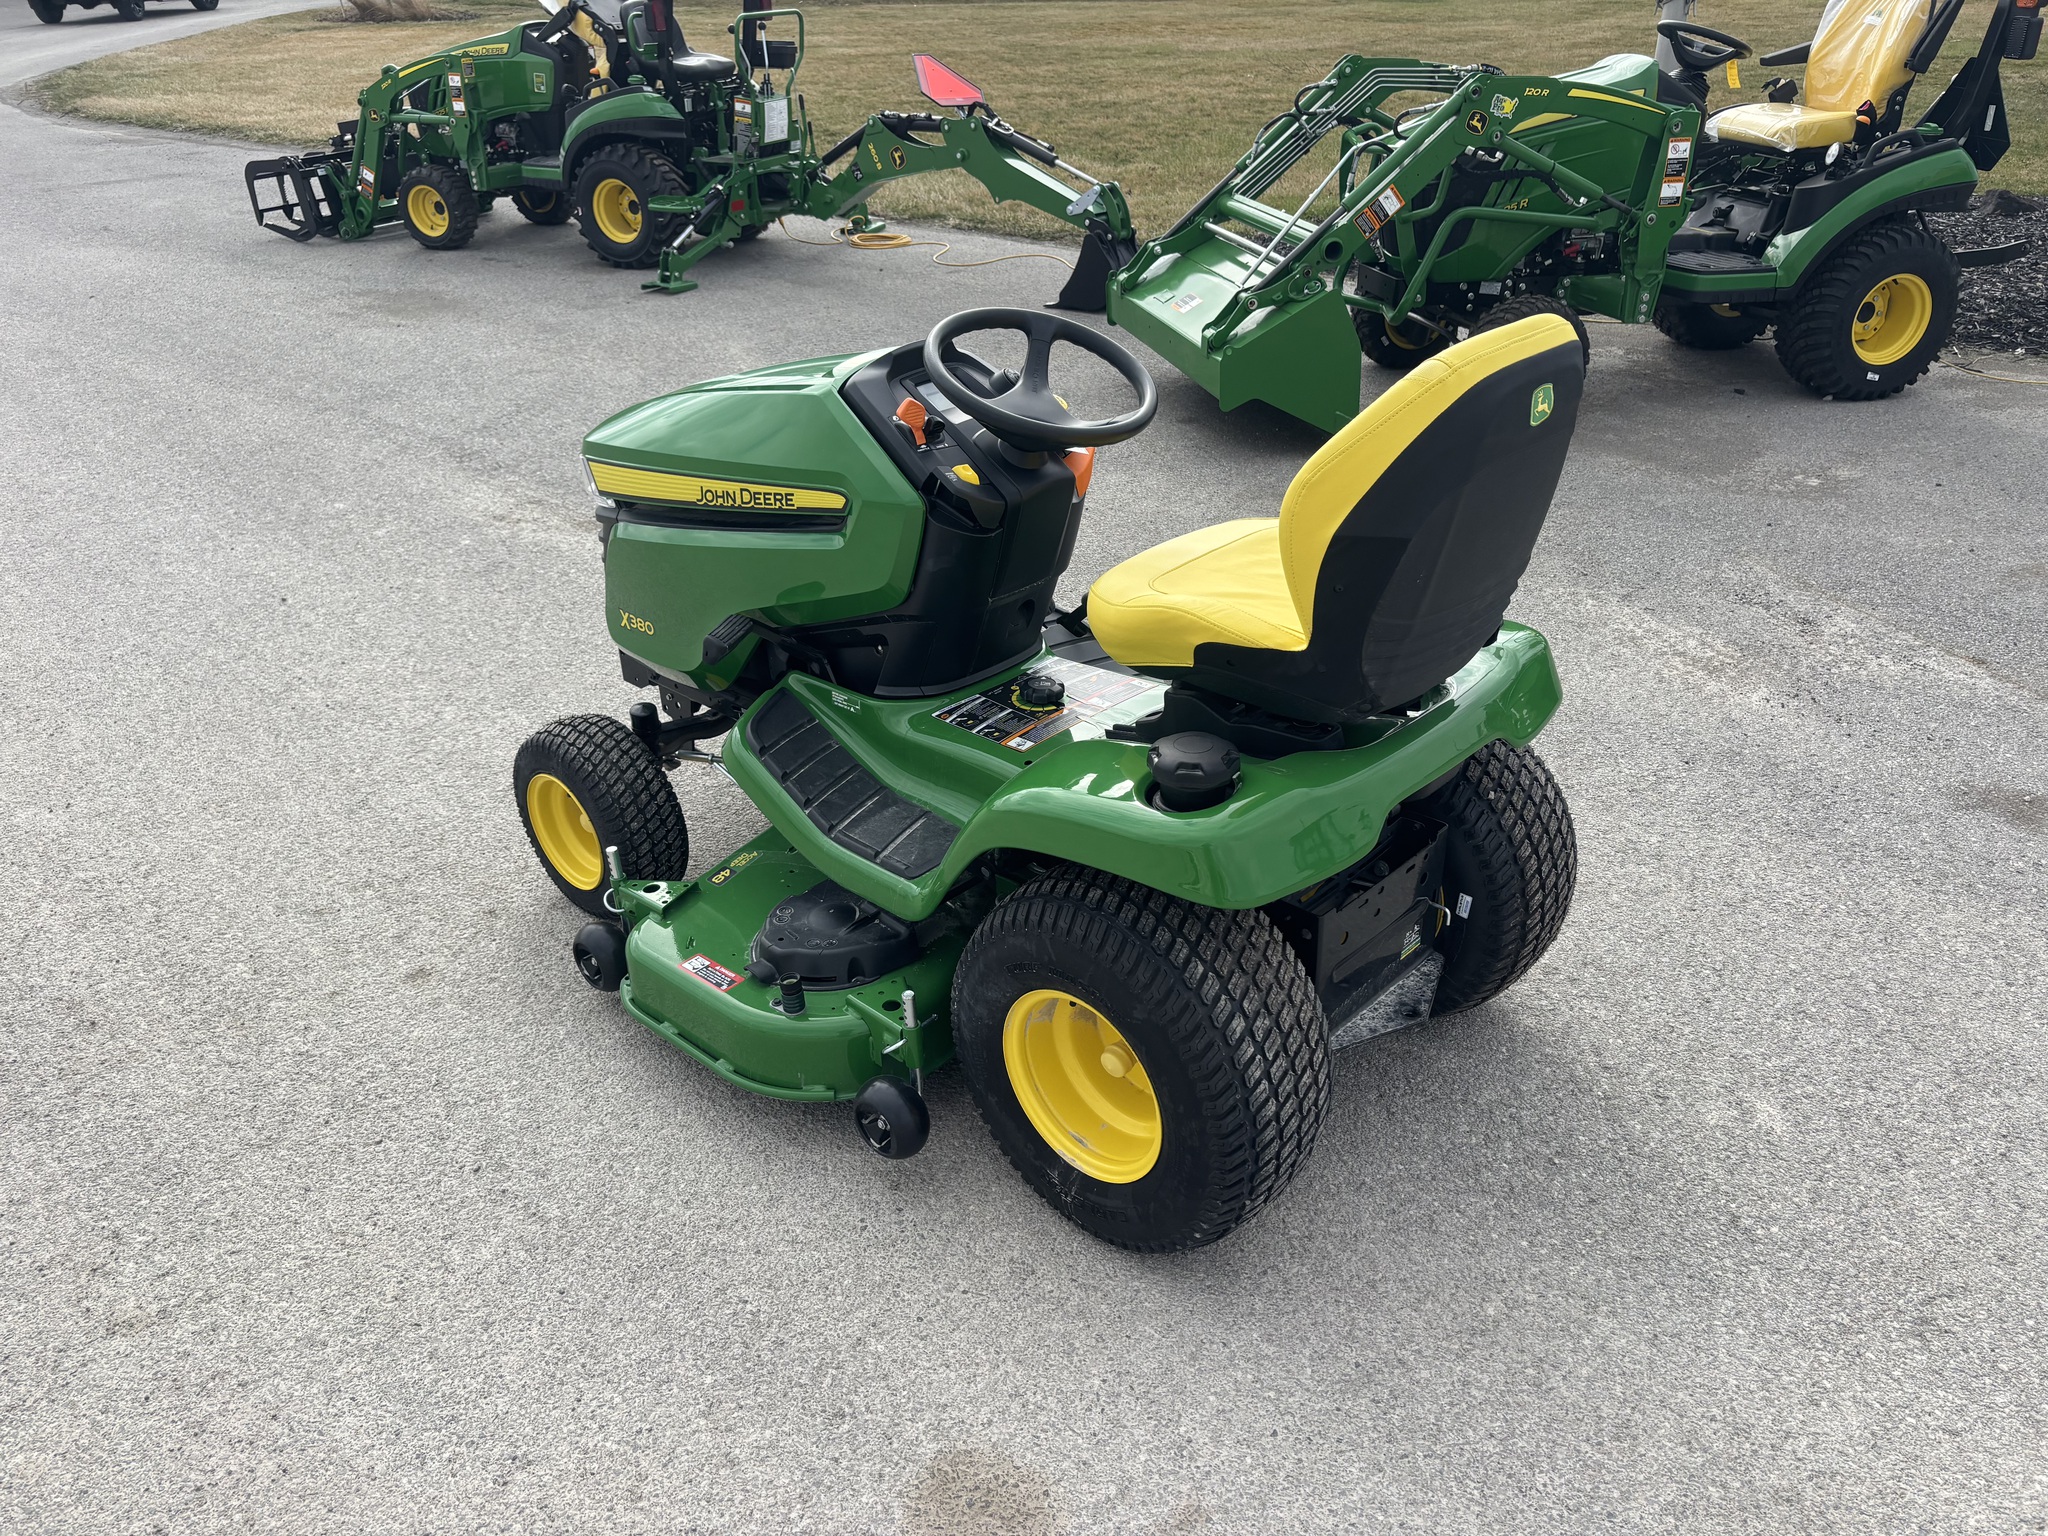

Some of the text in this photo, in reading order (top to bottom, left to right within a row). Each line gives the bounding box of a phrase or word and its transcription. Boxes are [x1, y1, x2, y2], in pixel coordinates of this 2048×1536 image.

[696, 486, 796, 508] JOHN DEERE
[619, 608, 655, 636] X380
[711, 868, 731, 884] 48
